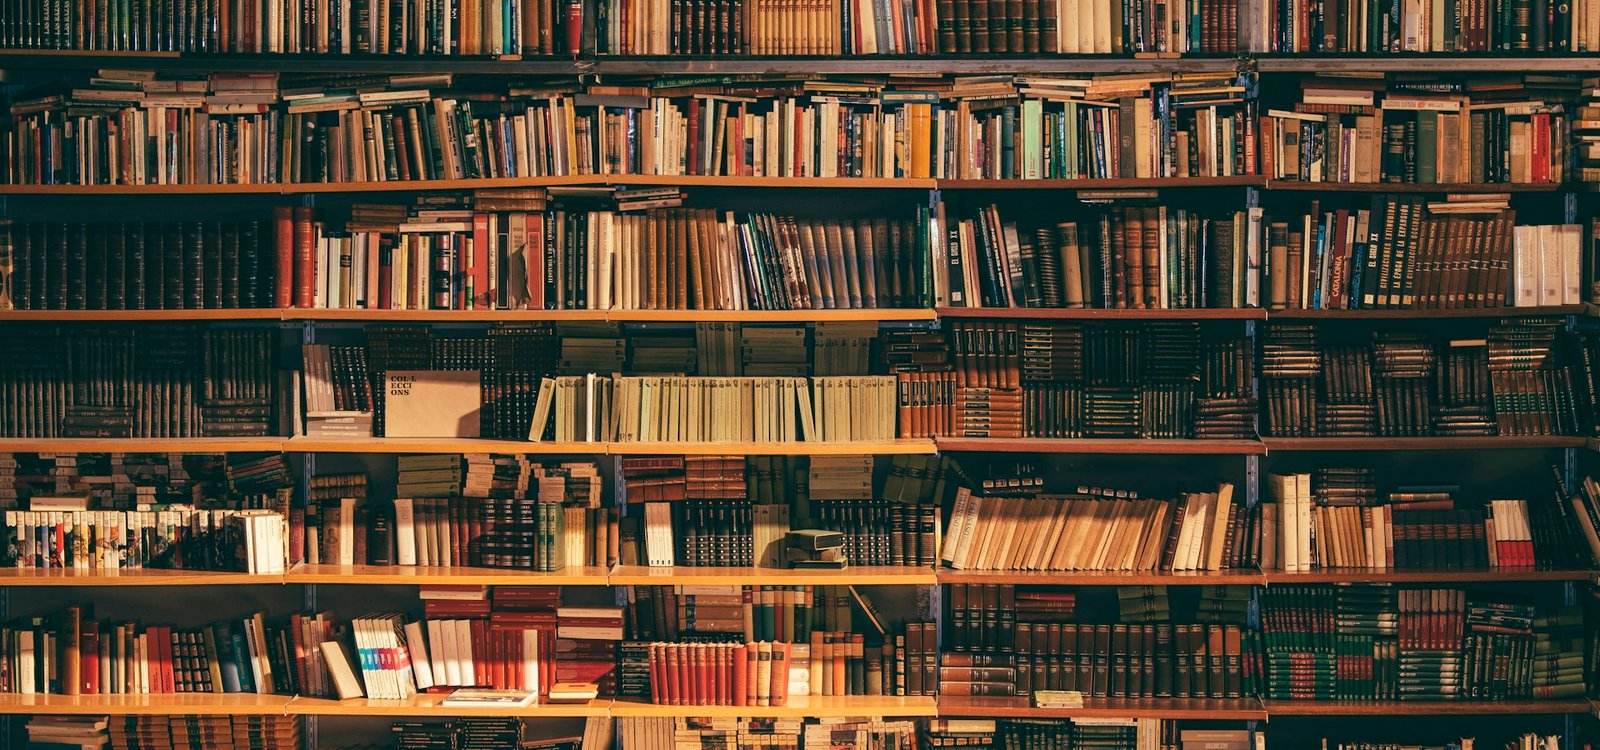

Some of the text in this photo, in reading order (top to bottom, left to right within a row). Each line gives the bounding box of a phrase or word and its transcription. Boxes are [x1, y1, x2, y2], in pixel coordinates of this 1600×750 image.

[950, 230, 958, 239] XX
[1398, 204, 1409, 237] EXPANSIÓN
[1410, 204, 1421, 239] OCCIDENTAL
[950, 242, 958, 256] SIGLO
[1369, 244, 1378, 259] SIGLO
[1370, 233, 1378, 242] XX
[1380, 201, 1396, 289] CIVILIZACIONES EXTINGUIDAS
[1396, 249, 1404, 258] DE
[1332, 255, 1342, 297] CATALONIA
[1393, 261, 1403, 279] ÉPOCA
[1405, 241, 1417, 279] CIVILIZACIÓN
[952, 493, 967, 527] PARNASO
[963, 502, 977, 537] PARNASO
